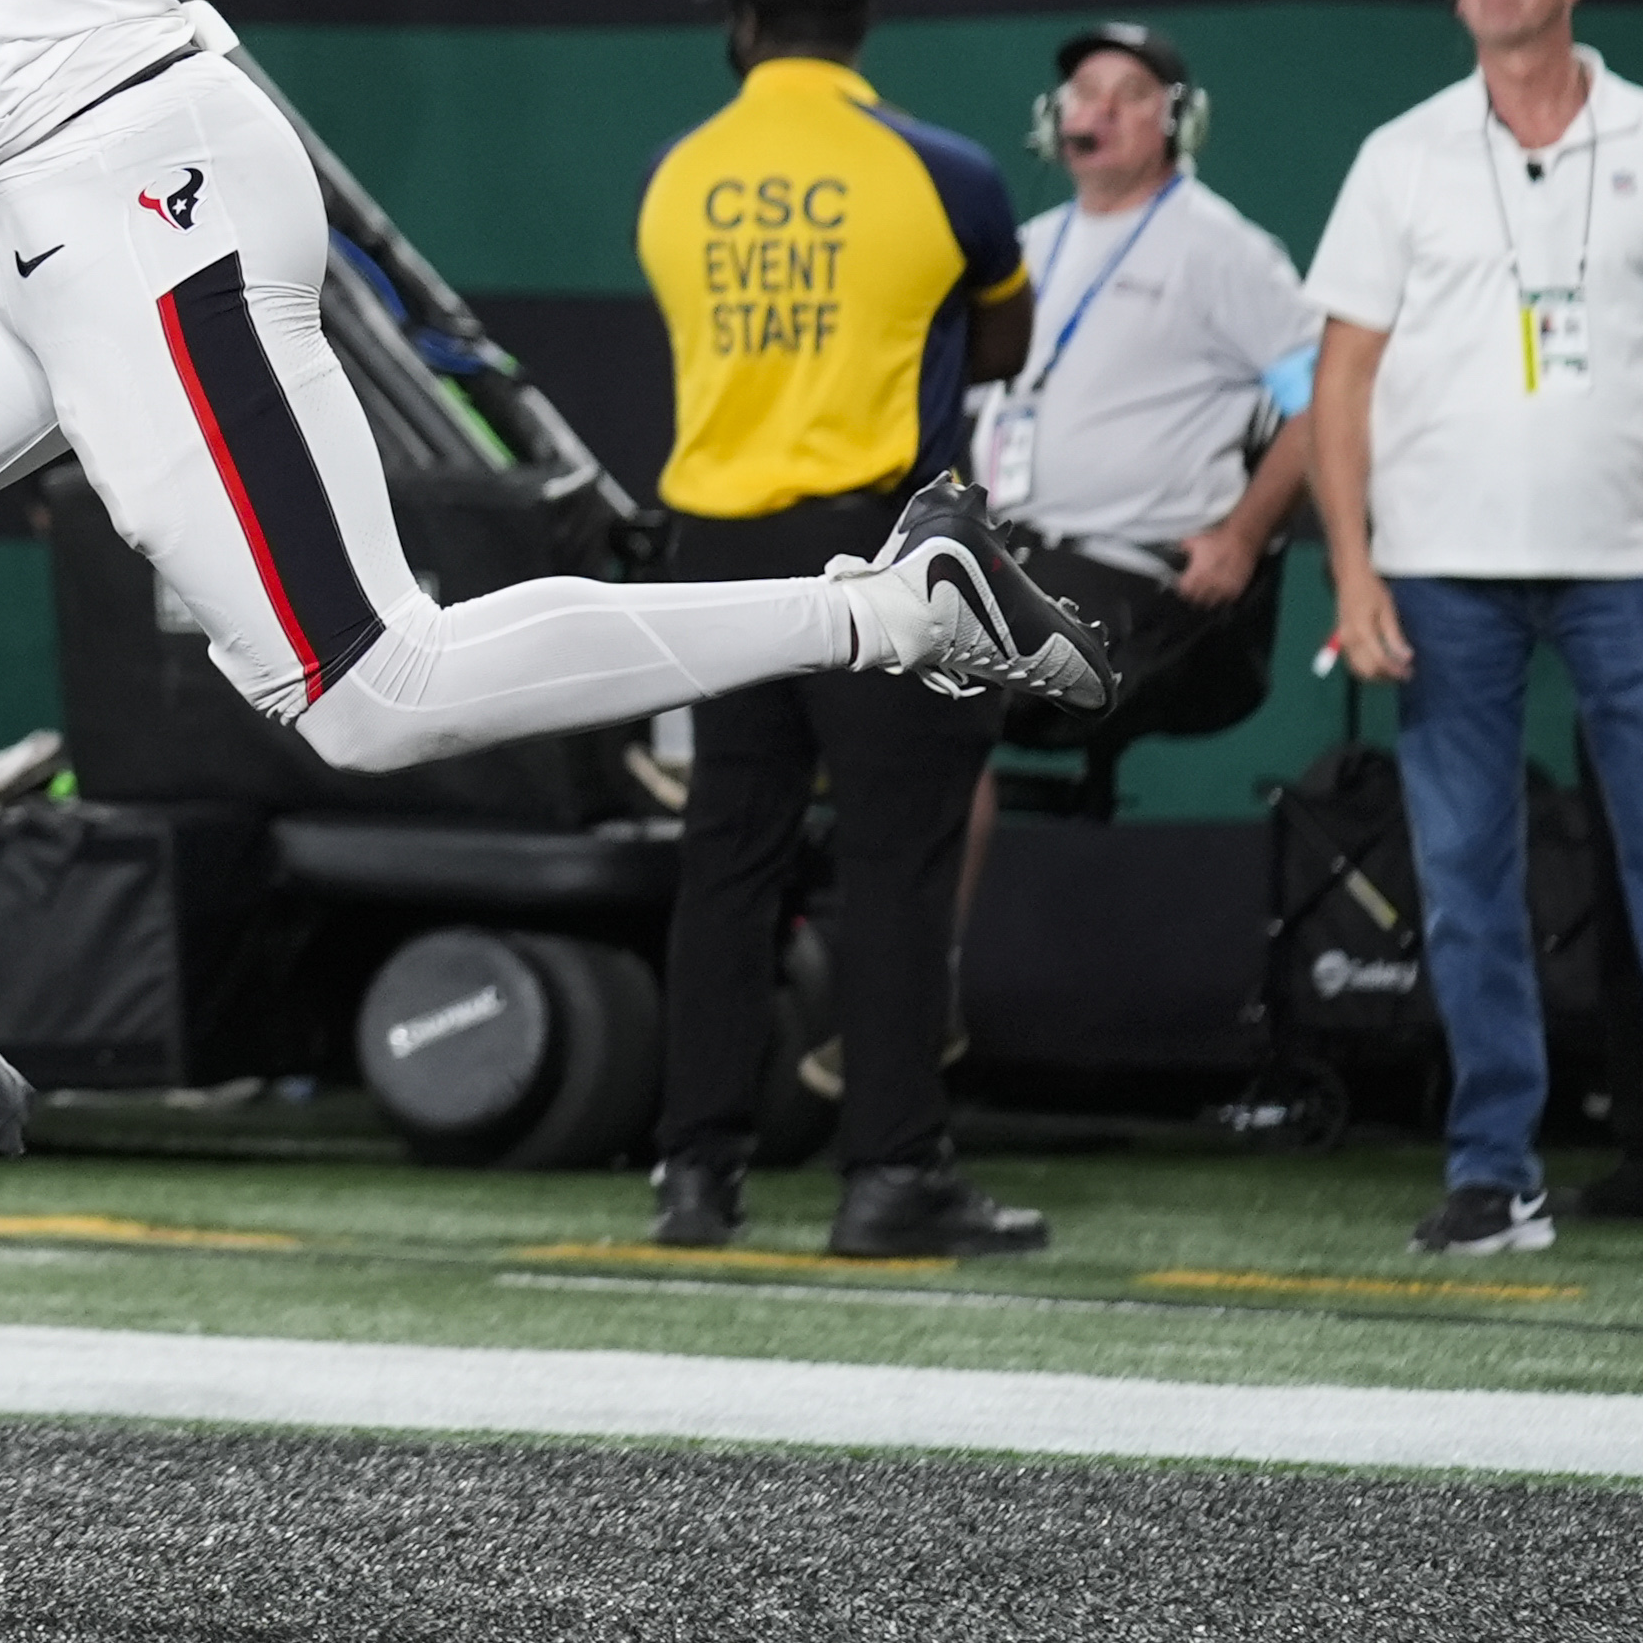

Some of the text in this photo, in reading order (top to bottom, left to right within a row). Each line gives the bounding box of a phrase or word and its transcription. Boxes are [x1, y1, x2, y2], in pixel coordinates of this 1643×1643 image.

[705, 177, 848, 229] CSC
[706, 239, 844, 292] EVENT
[712, 300, 840, 355] STAFF
